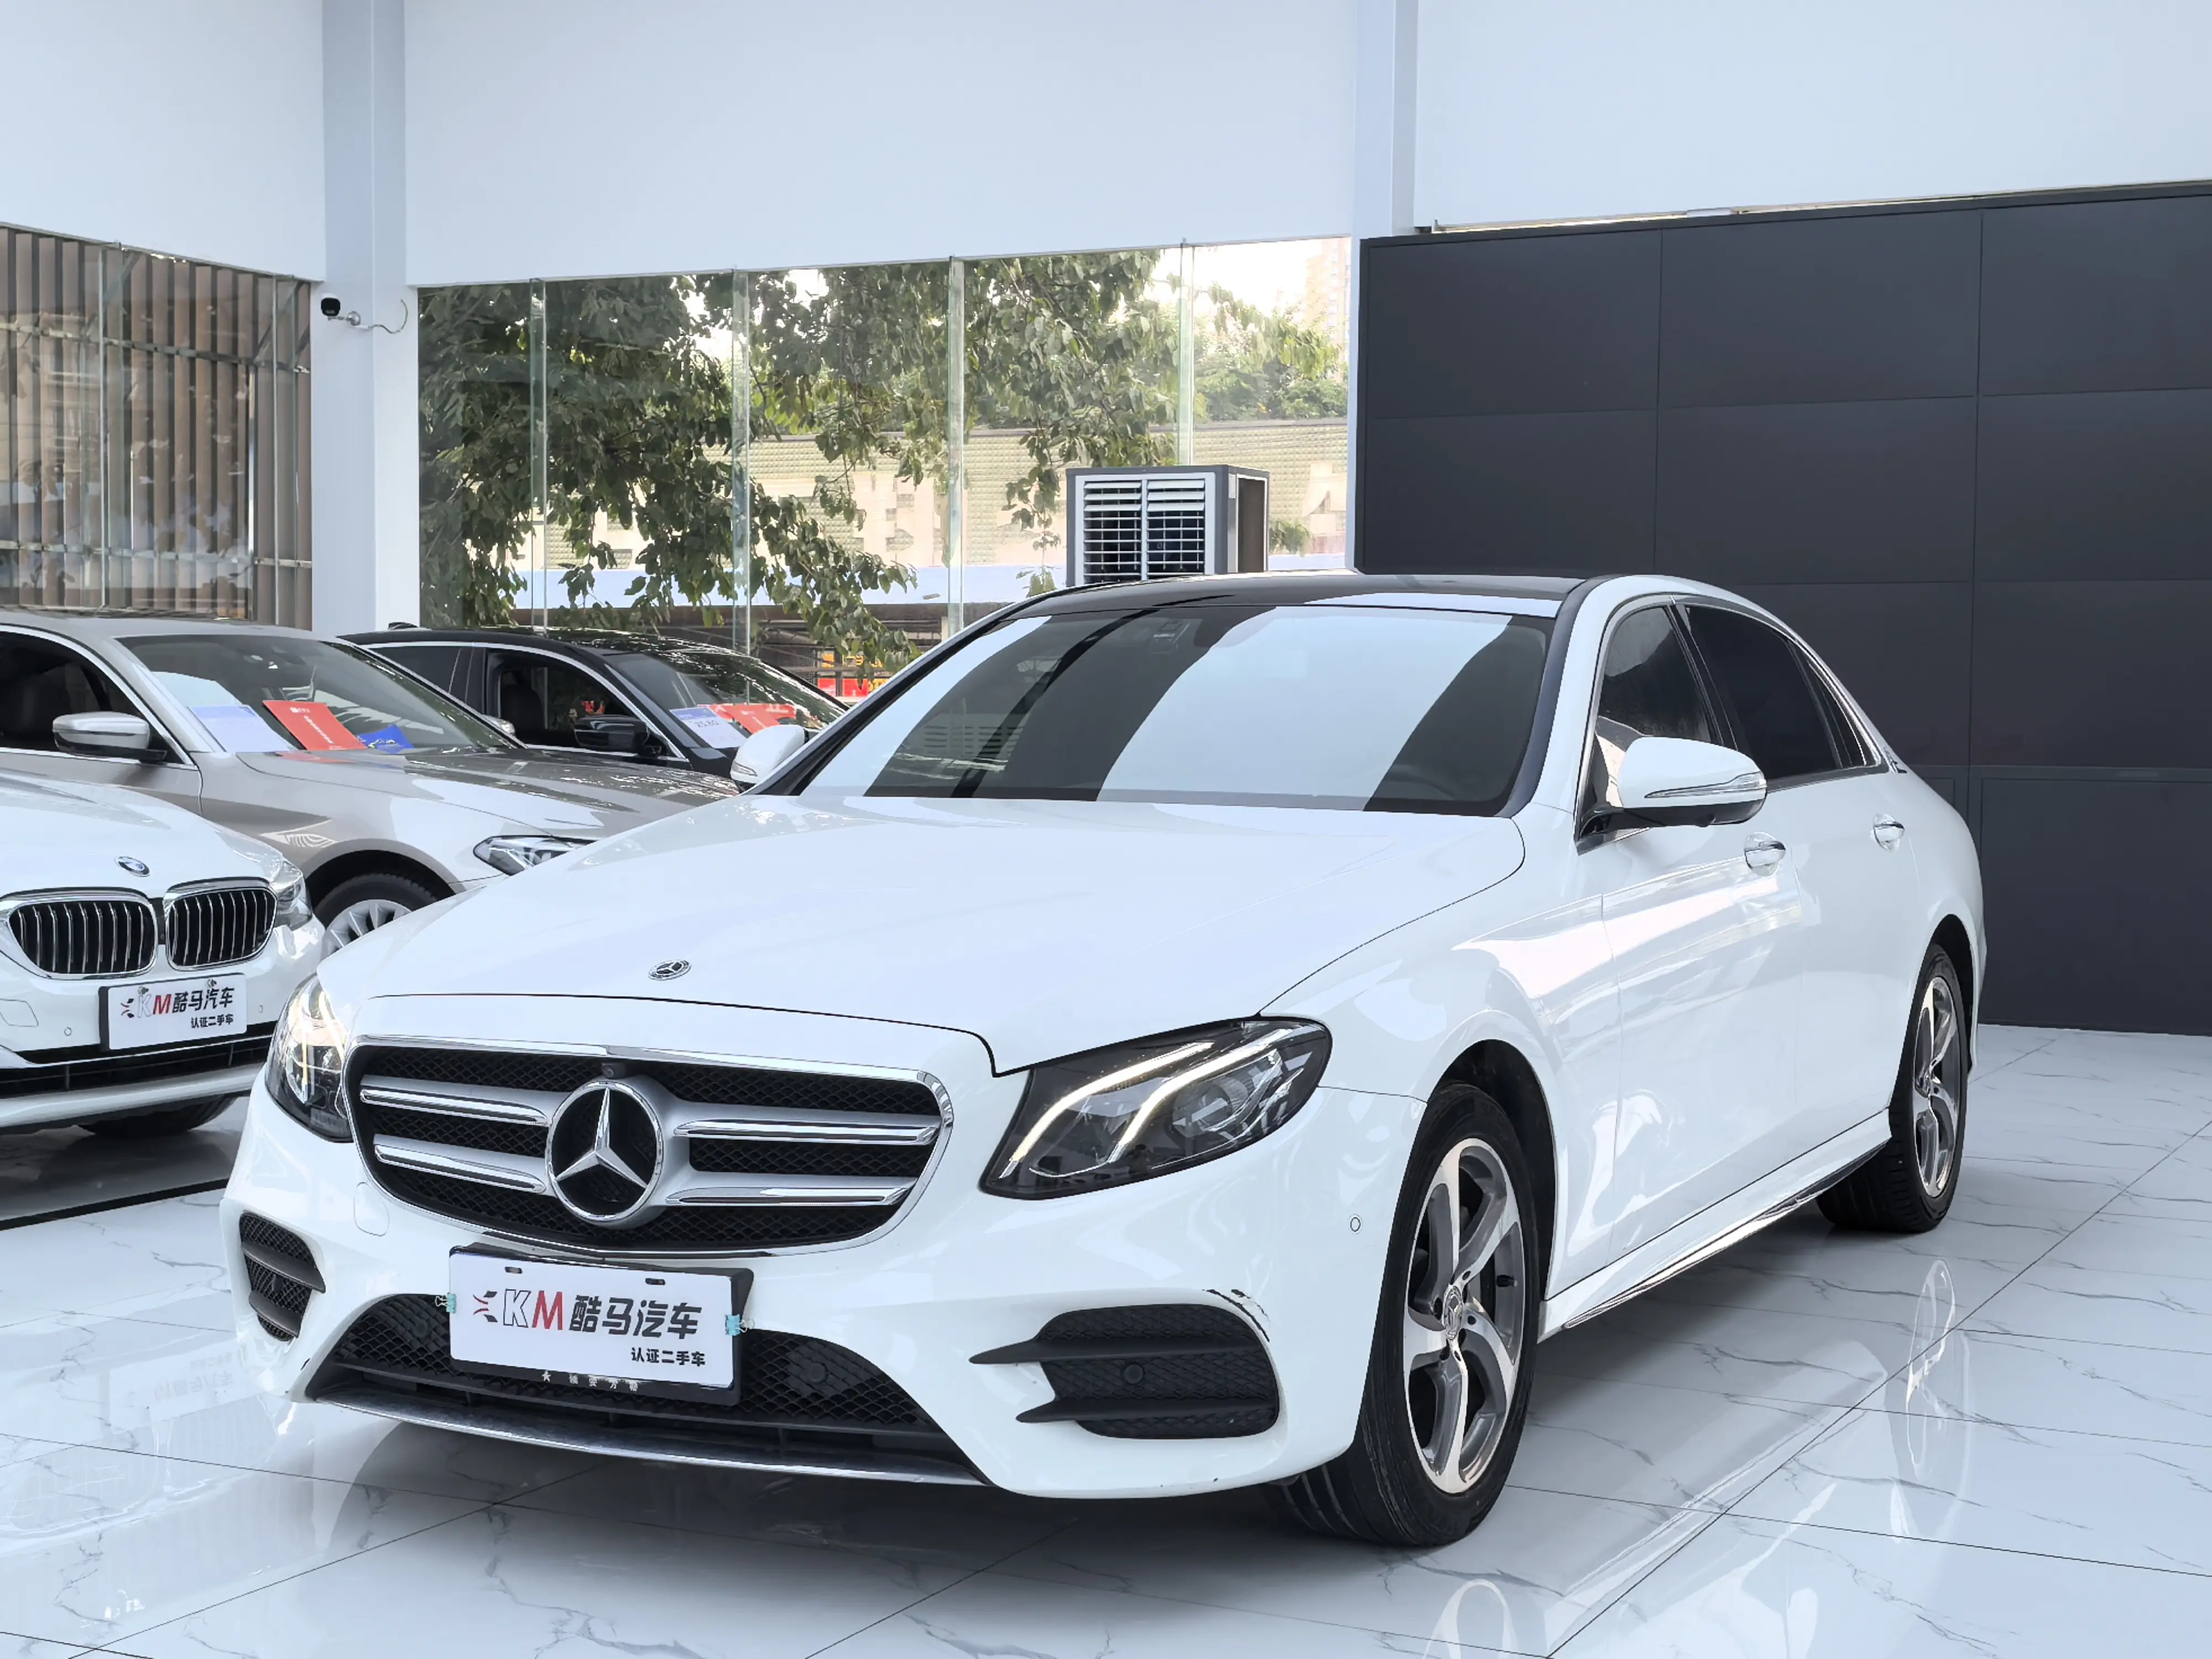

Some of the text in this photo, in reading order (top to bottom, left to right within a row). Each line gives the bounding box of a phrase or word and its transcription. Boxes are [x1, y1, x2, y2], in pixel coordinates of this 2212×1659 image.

[137, 987, 234, 1018] KM 酷马汽车
[191, 1014, 233, 1029] 认证二手车
[503, 1288, 702, 1339] KM 酷马汽车
[631, 1347, 706, 1367] 认证二手车
